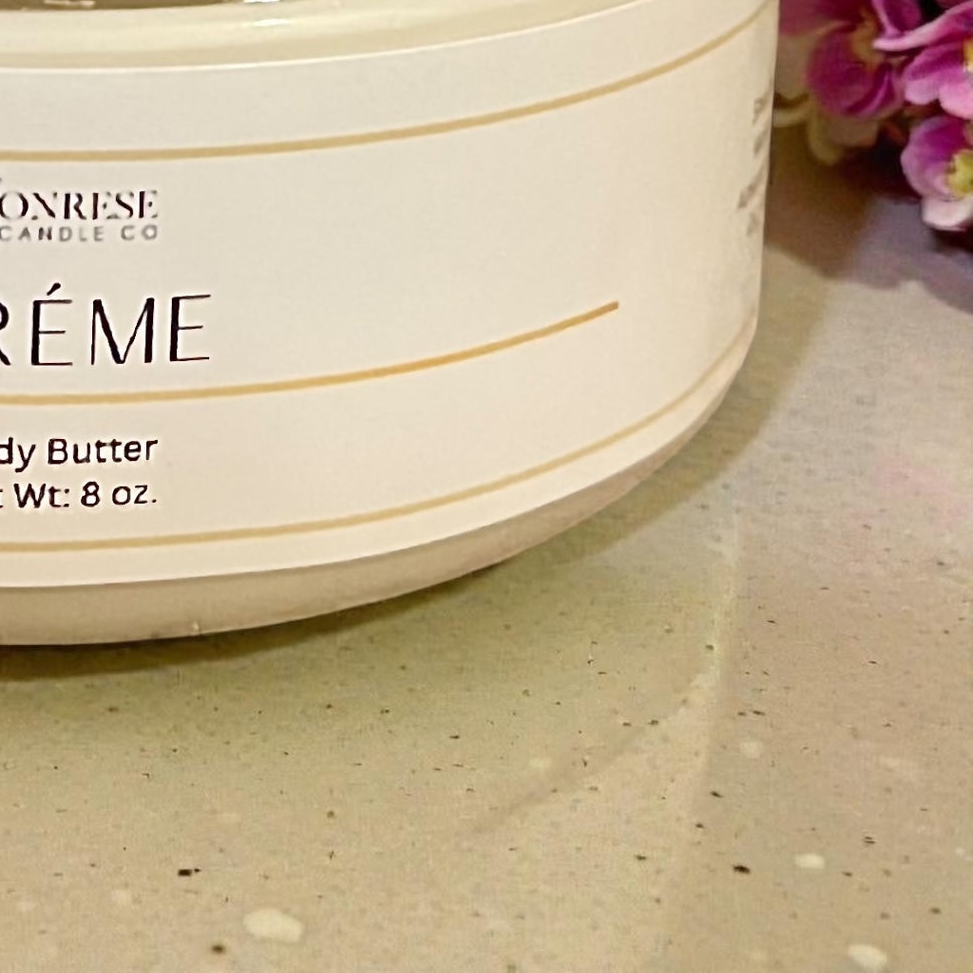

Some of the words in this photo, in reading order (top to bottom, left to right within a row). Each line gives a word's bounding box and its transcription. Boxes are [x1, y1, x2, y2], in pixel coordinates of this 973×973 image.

[120, 224, 158, 241] CO
[47, 438, 159, 466] Butter
[13, 483, 71, 509] Wt:
[81, 481, 101, 508] 8
[112, 484, 158, 506] oz.
